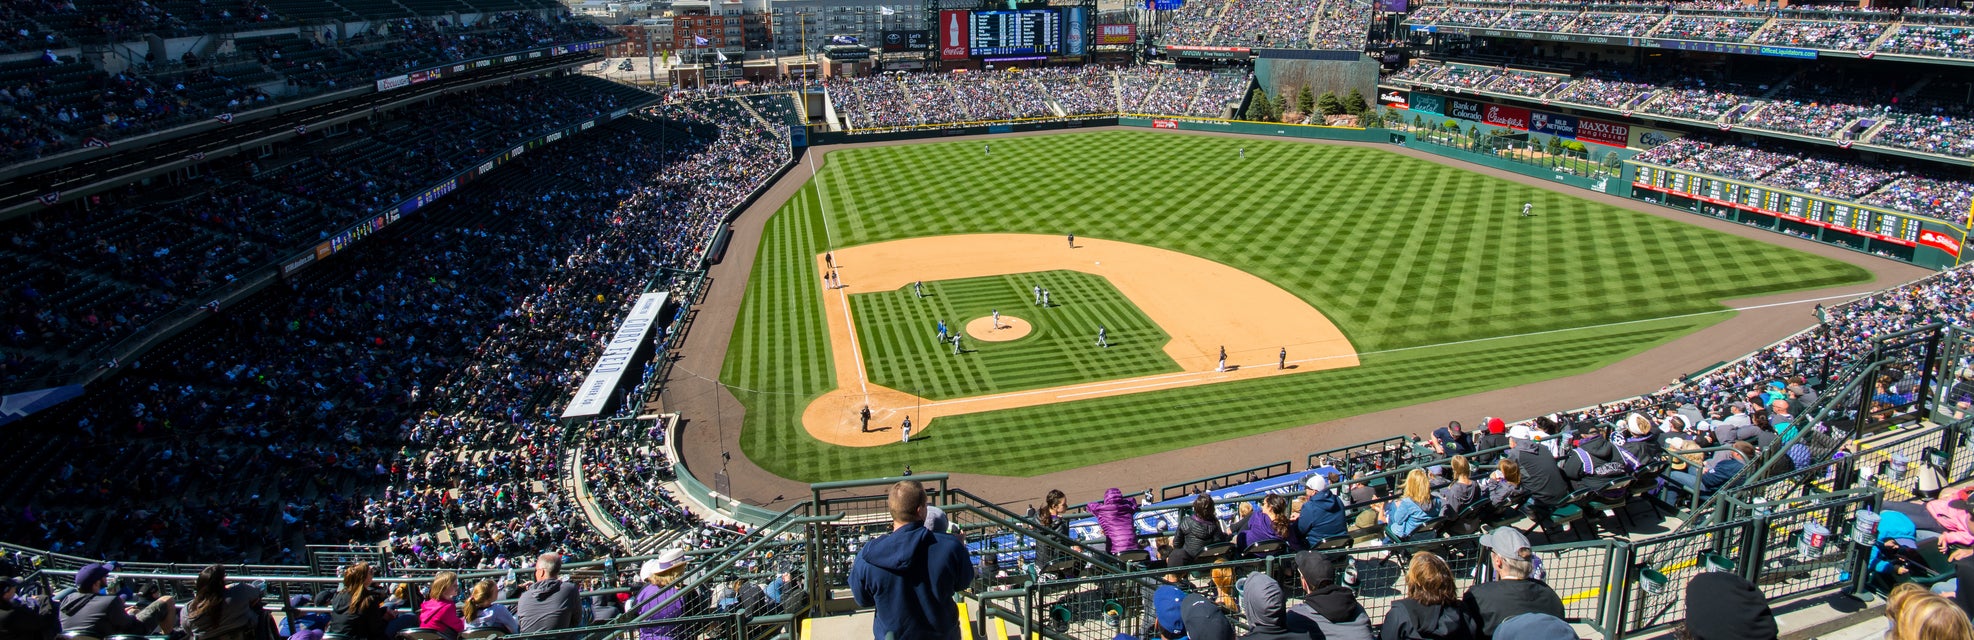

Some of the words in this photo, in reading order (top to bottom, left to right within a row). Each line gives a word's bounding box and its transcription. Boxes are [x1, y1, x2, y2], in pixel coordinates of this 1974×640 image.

[1104, 26, 1129, 35] KING
[944, 47, 964, 56] Coca-Cola
[1761, 47, 1816, 57] OfficeLiquidators.com
[1381, 93, 1405, 103] Safelite
[1414, 103, 1439, 112] dental
[1454, 101, 1468, 109] Bank
[1453, 109, 1482, 120] Colorado
[1546, 123, 1574, 132] NETWORK
[1579, 120, 1610, 133] MAXX
[1612, 126, 1627, 136] HD
[1578, 129, 1626, 142] sunglasses
[613, 318, 649, 344] COORS
[595, 347, 632, 373] FIELD
